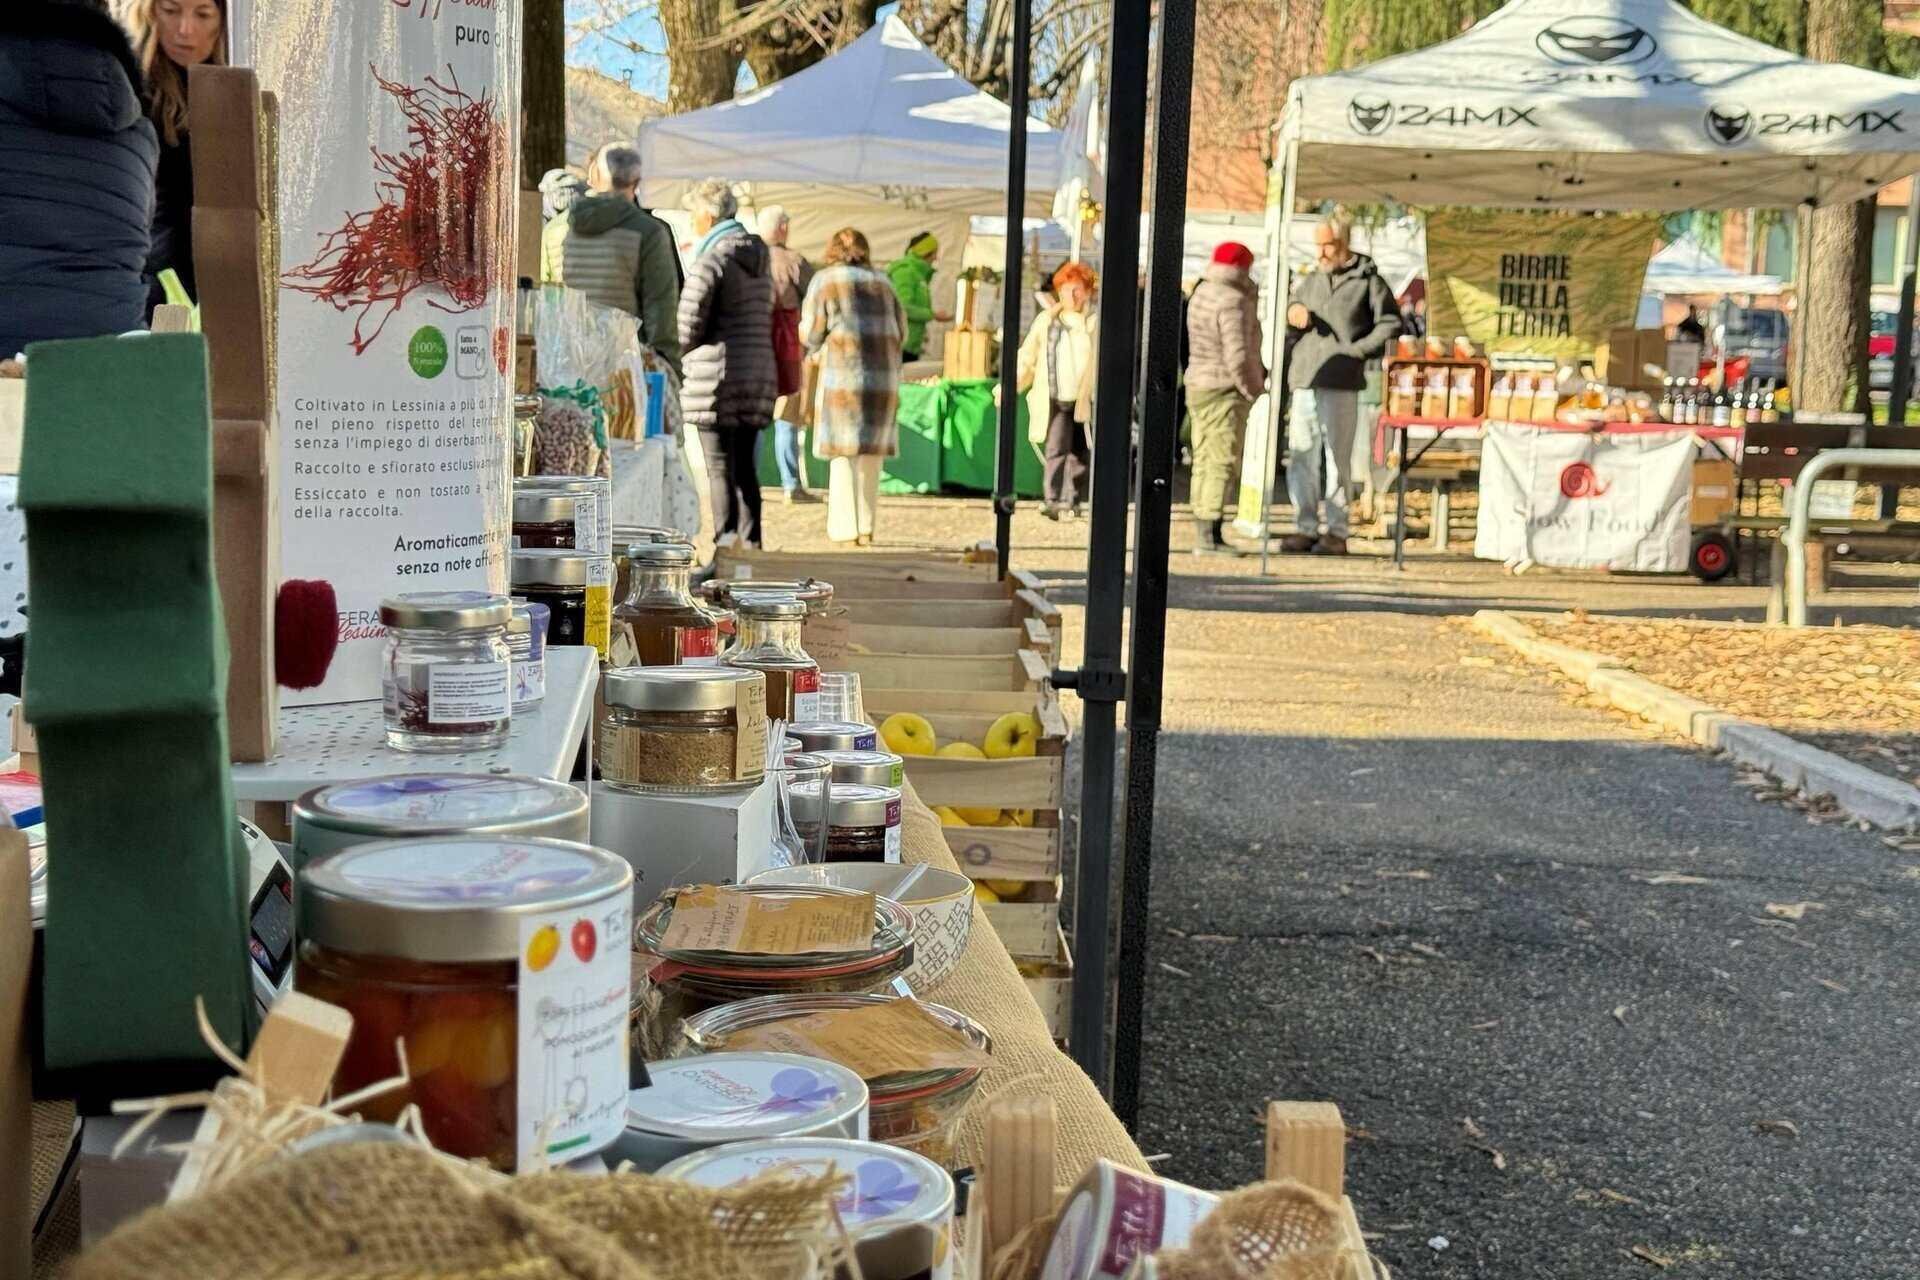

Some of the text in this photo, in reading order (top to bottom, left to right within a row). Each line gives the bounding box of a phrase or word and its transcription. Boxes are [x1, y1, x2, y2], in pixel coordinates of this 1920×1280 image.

[456, 24, 490, 46] puro
[1398, 104, 1540, 127] 24MX
[1759, 108, 1905, 134] 24MX
[1502, 254, 1570, 280] BIRRE
[1500, 283, 1568, 309] DELLA
[1497, 311, 1570, 338] TERRA
[294, 398, 365, 411] Coltivato
[373, 399, 385, 412] in
[392, 399, 445, 411] Lessinia
[450, 401, 456, 411] a
[460, 398, 476, 413] più
[295, 416, 318, 431] nel
[332, 417, 374, 433] pieno
[386, 417, 440, 433] rispetto
[448, 417, 465, 429] del
[294, 439, 339, 449] senza
[346, 436, 413, 452] l'impiego
[418, 436, 430, 448] di
[435, 433, 486, 448] diserbanti
[294, 461, 361, 474] Raccolto
[367, 464, 376, 474] e
[381, 460, 435, 474] sfiorato
[294, 487, 367, 500] Essiccato
[377, 489, 385, 499] e
[396, 486, 421, 498] non
[430, 484, 470, 497] tostato
[294, 503, 403, 518] della raccolta.
[396, 561, 440, 575] senza
[445, 556, 472, 572] note
